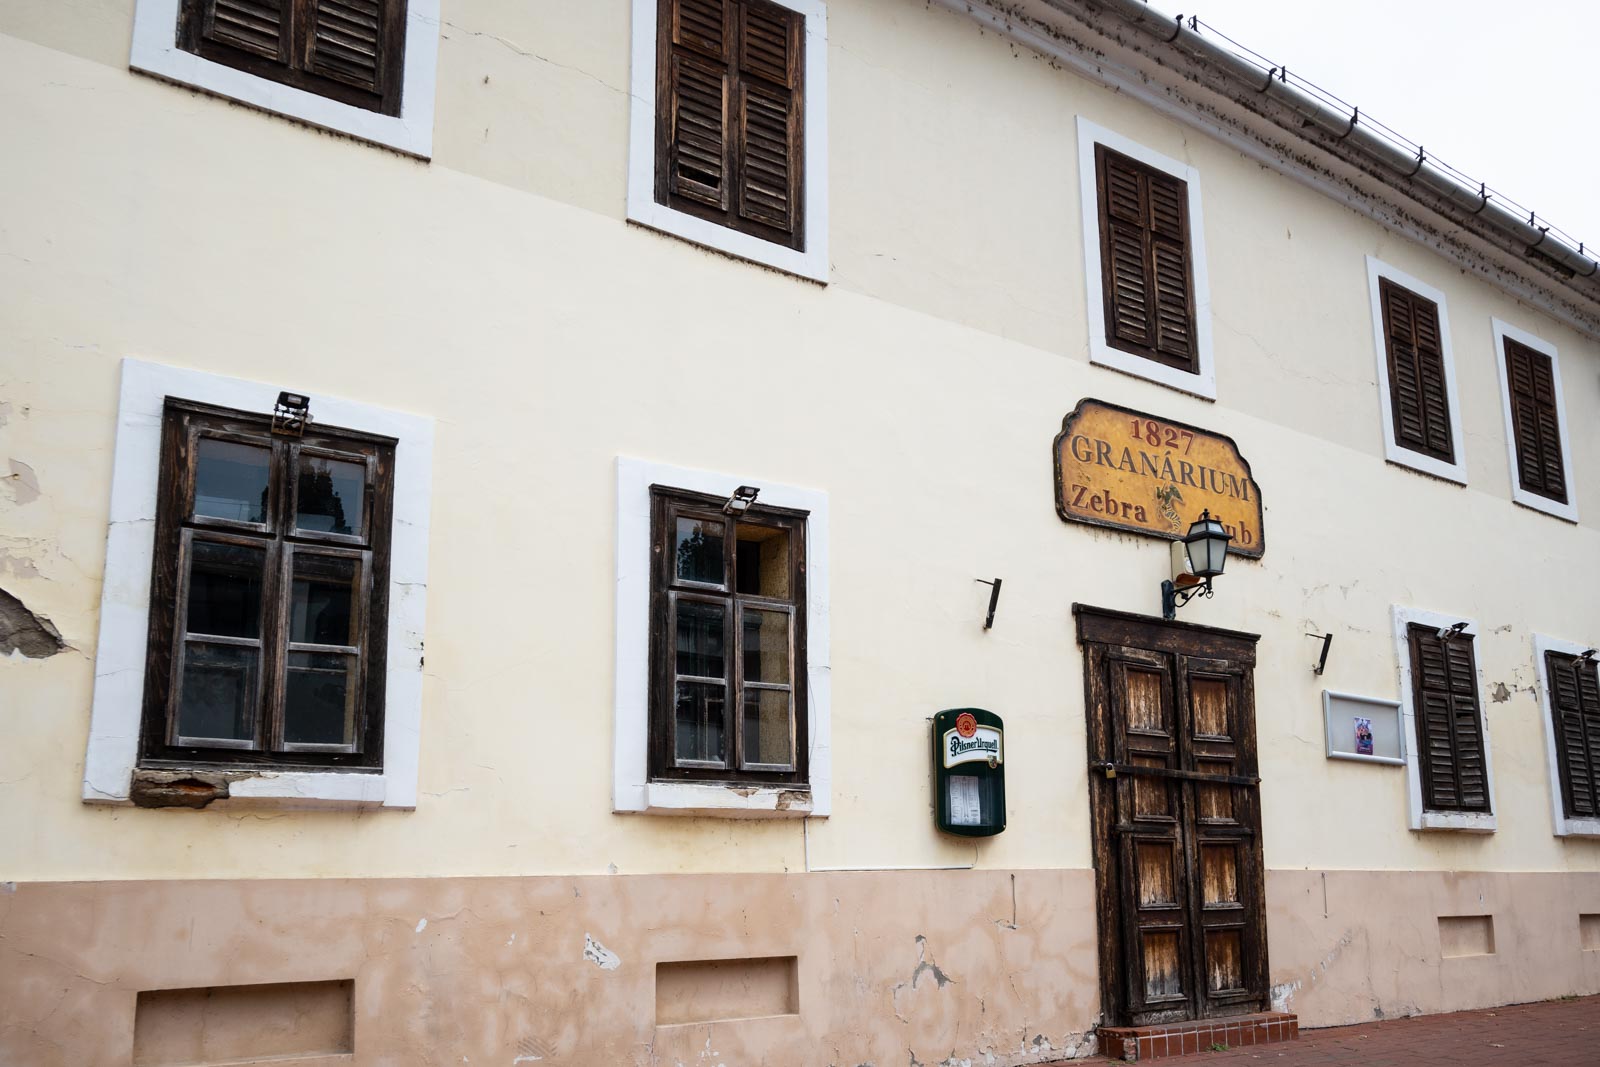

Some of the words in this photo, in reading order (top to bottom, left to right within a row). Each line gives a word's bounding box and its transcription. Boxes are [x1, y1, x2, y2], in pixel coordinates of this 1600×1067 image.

[1131, 419, 1194, 455] 1827
[1071, 435, 1250, 501] GRANÁRIUM
[1072, 484, 1148, 522] Zebra
[1198, 512, 1252, 545] ub
[950, 736, 977, 757] Pilsner
[976, 737, 998, 752] Urquell
